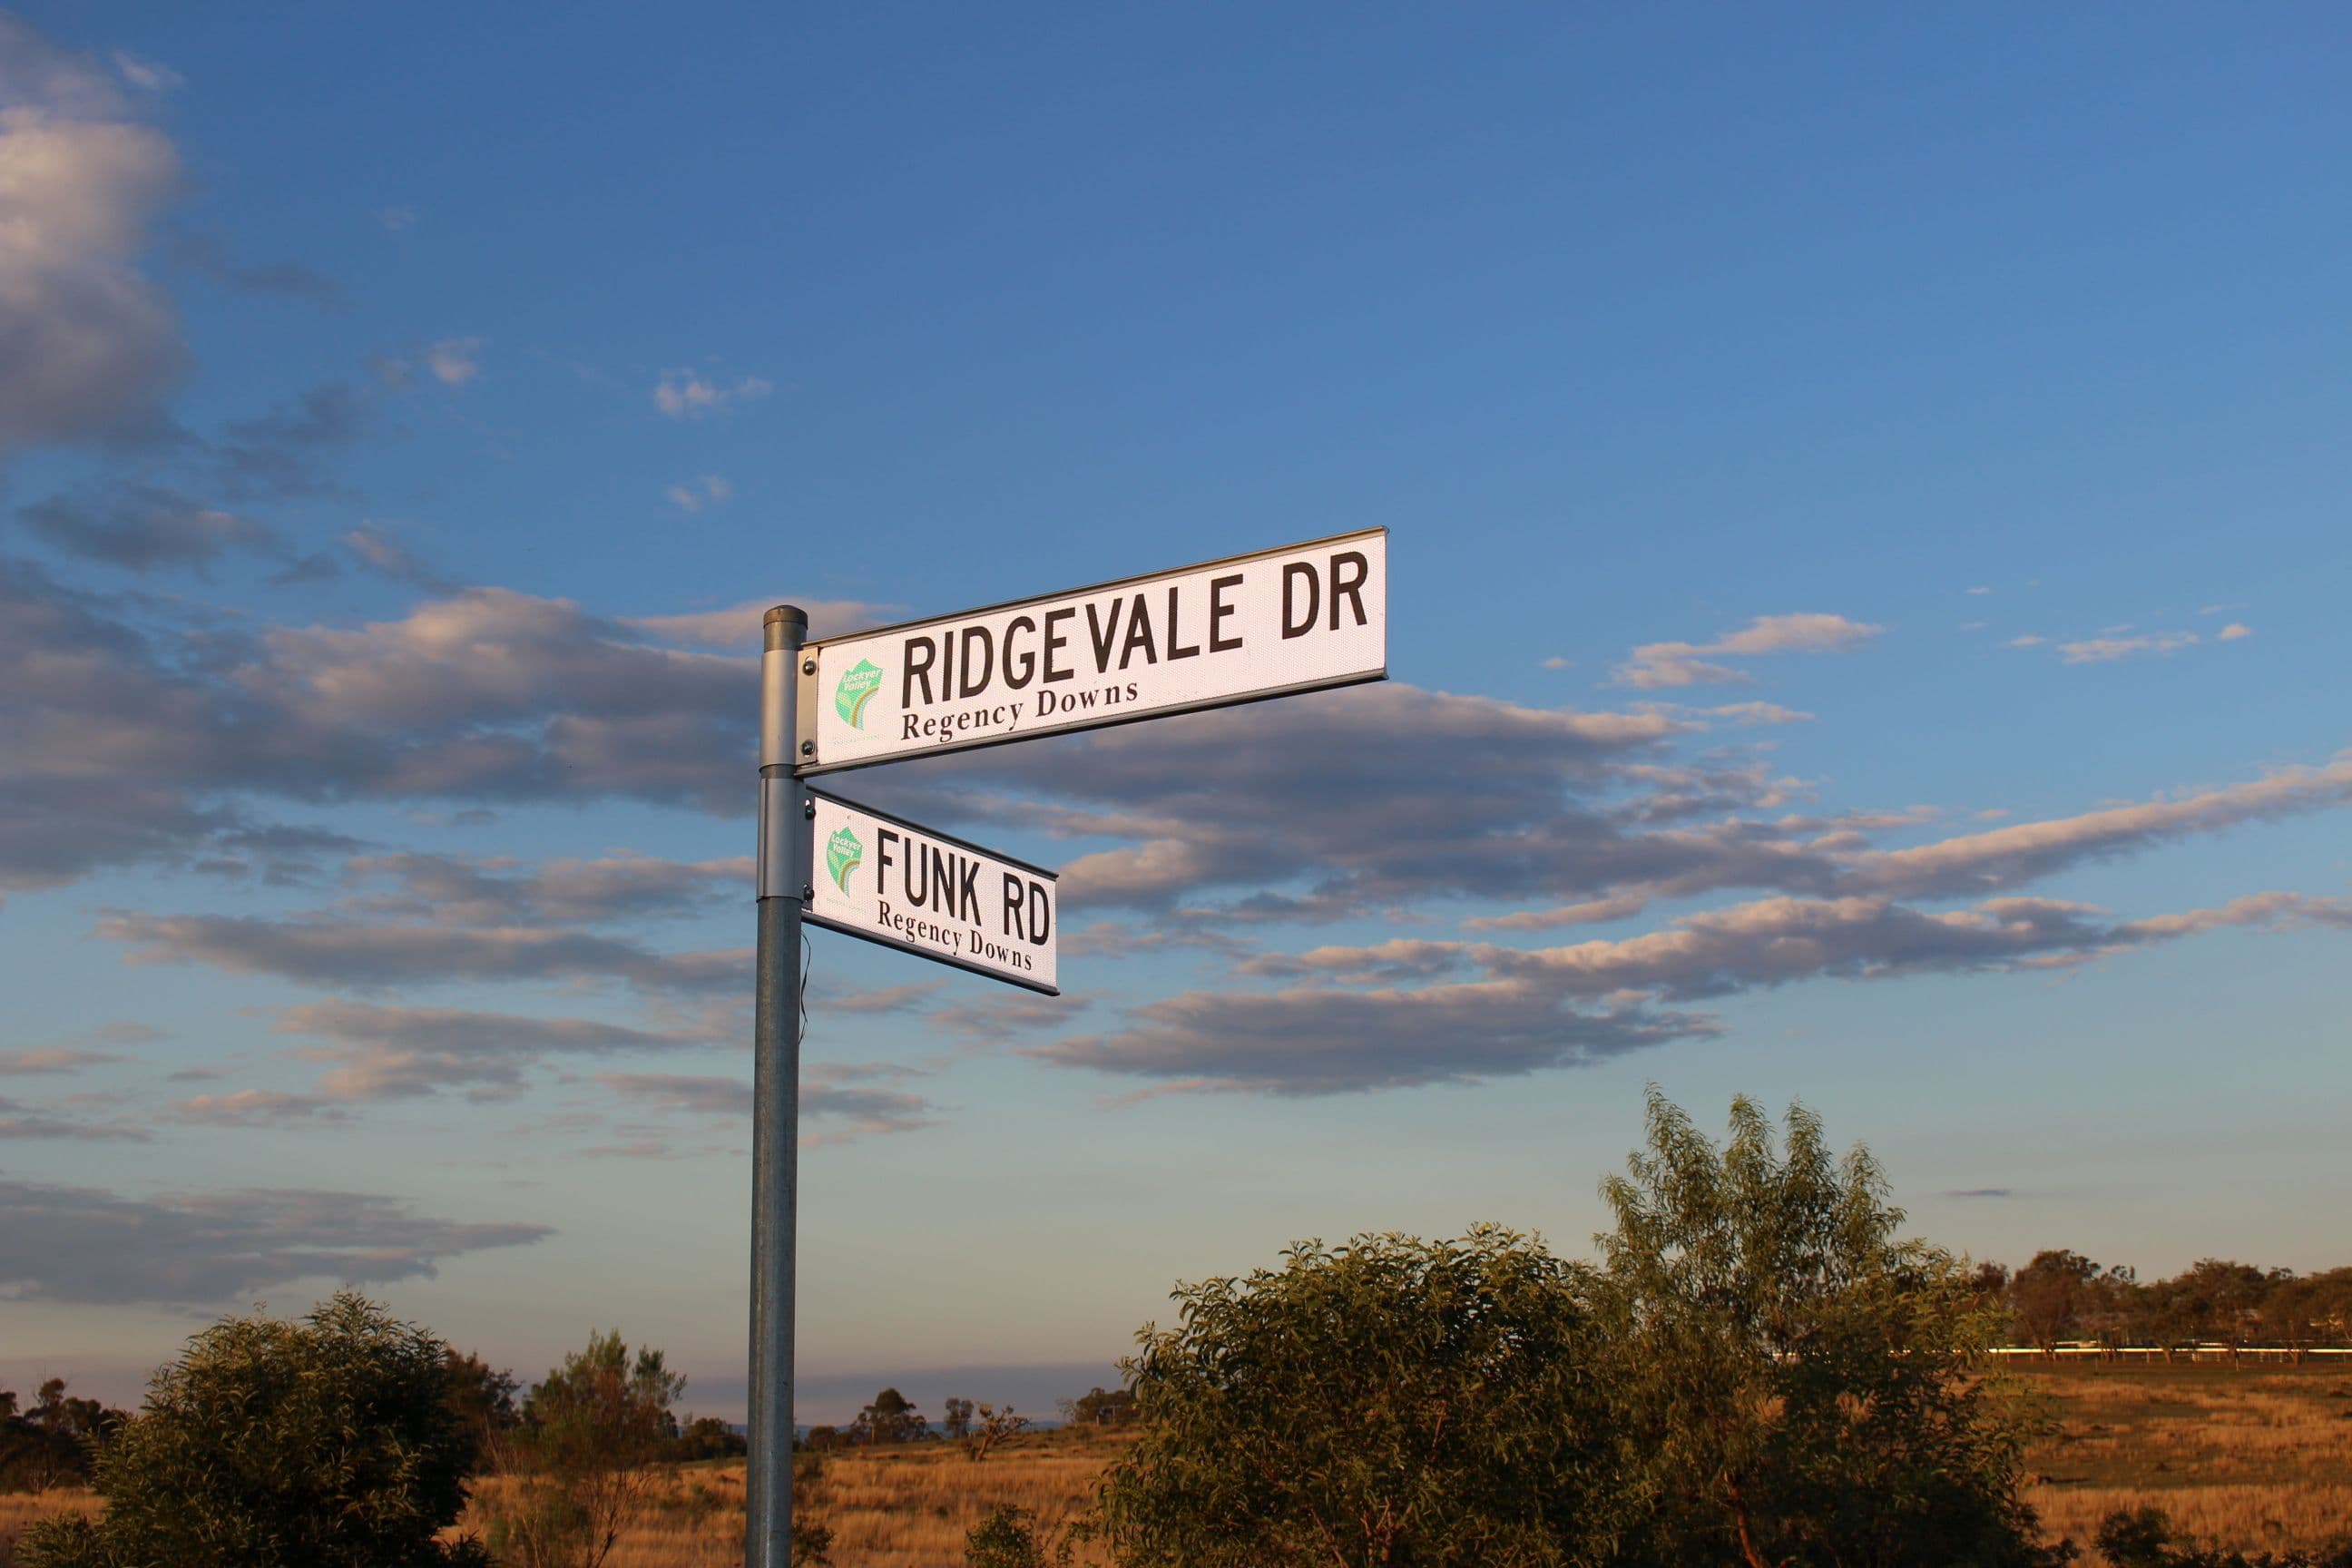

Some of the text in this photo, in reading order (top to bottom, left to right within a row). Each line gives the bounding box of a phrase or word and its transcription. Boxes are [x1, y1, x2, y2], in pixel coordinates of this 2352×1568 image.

[901, 551, 1368, 710] RIDGEVALE DR
[900, 682, 1138, 743] Regency Downs
[877, 827, 1050, 946] FUNK RD
[877, 899, 1033, 972] Regency Downs
